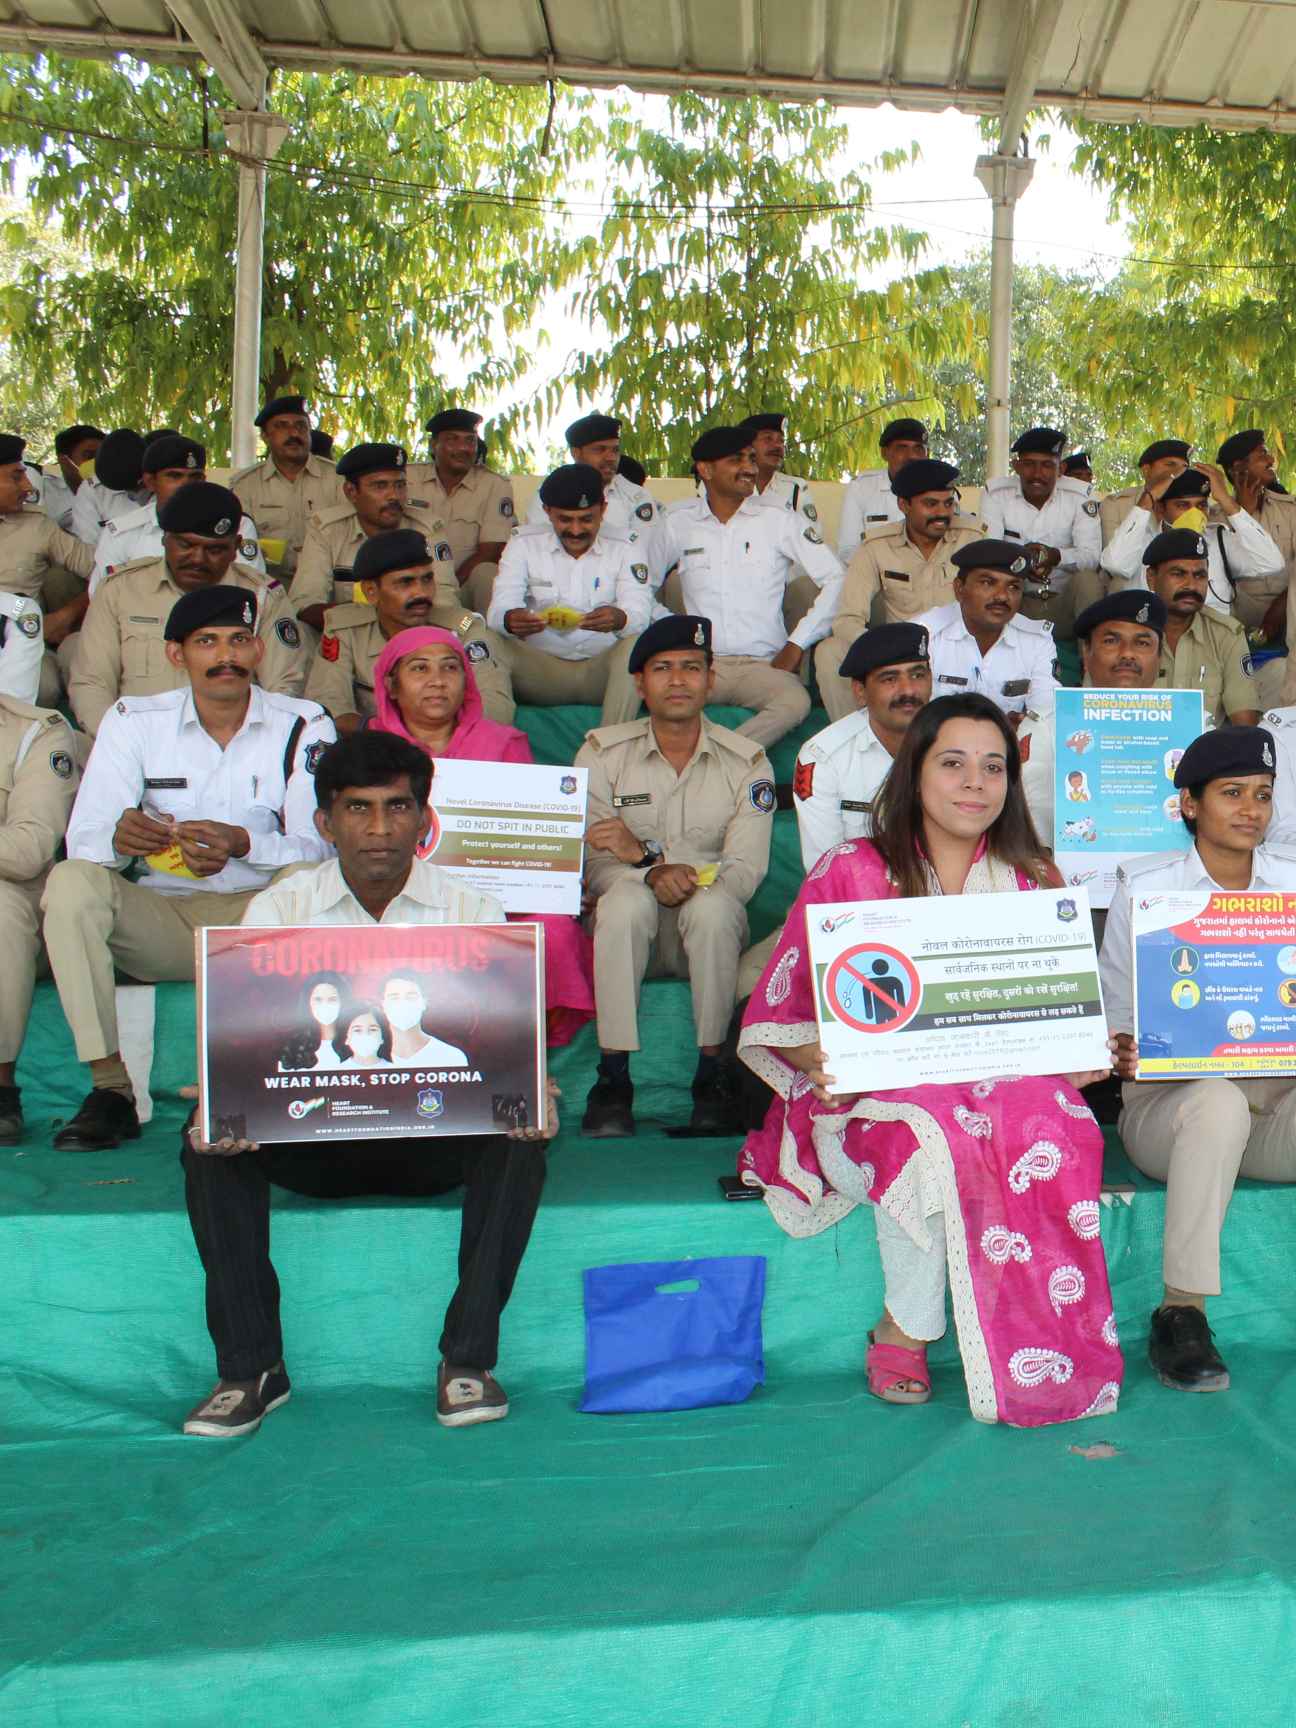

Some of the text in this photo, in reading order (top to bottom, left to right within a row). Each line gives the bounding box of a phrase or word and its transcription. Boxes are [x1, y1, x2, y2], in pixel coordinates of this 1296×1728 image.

[1083, 699, 1173, 710] CORONAVIRUS
[1117, 693, 1140, 701] YOUR
[1083, 708, 1173, 722] INFECTION
[469, 799, 513, 809] Coronavirus
[513, 801, 541, 810] Disease
[456, 819, 569, 835] DO NOT SPIT IN PUBLIC
[462, 839, 489, 850] Protect
[490, 841, 521, 852] yourself
[521, 843, 536, 851] and
[1211, 891, 1284, 912] ગભરાશો
[952, 935, 1014, 950] कोरोनावायरस
[1016, 932, 1033, 945] रोग
[943, 959, 989, 975] सार्वजनिक
[1016, 960, 1030, 971] पर
[264, 1070, 483, 1090] WEAR MASK, STOP CORONA
